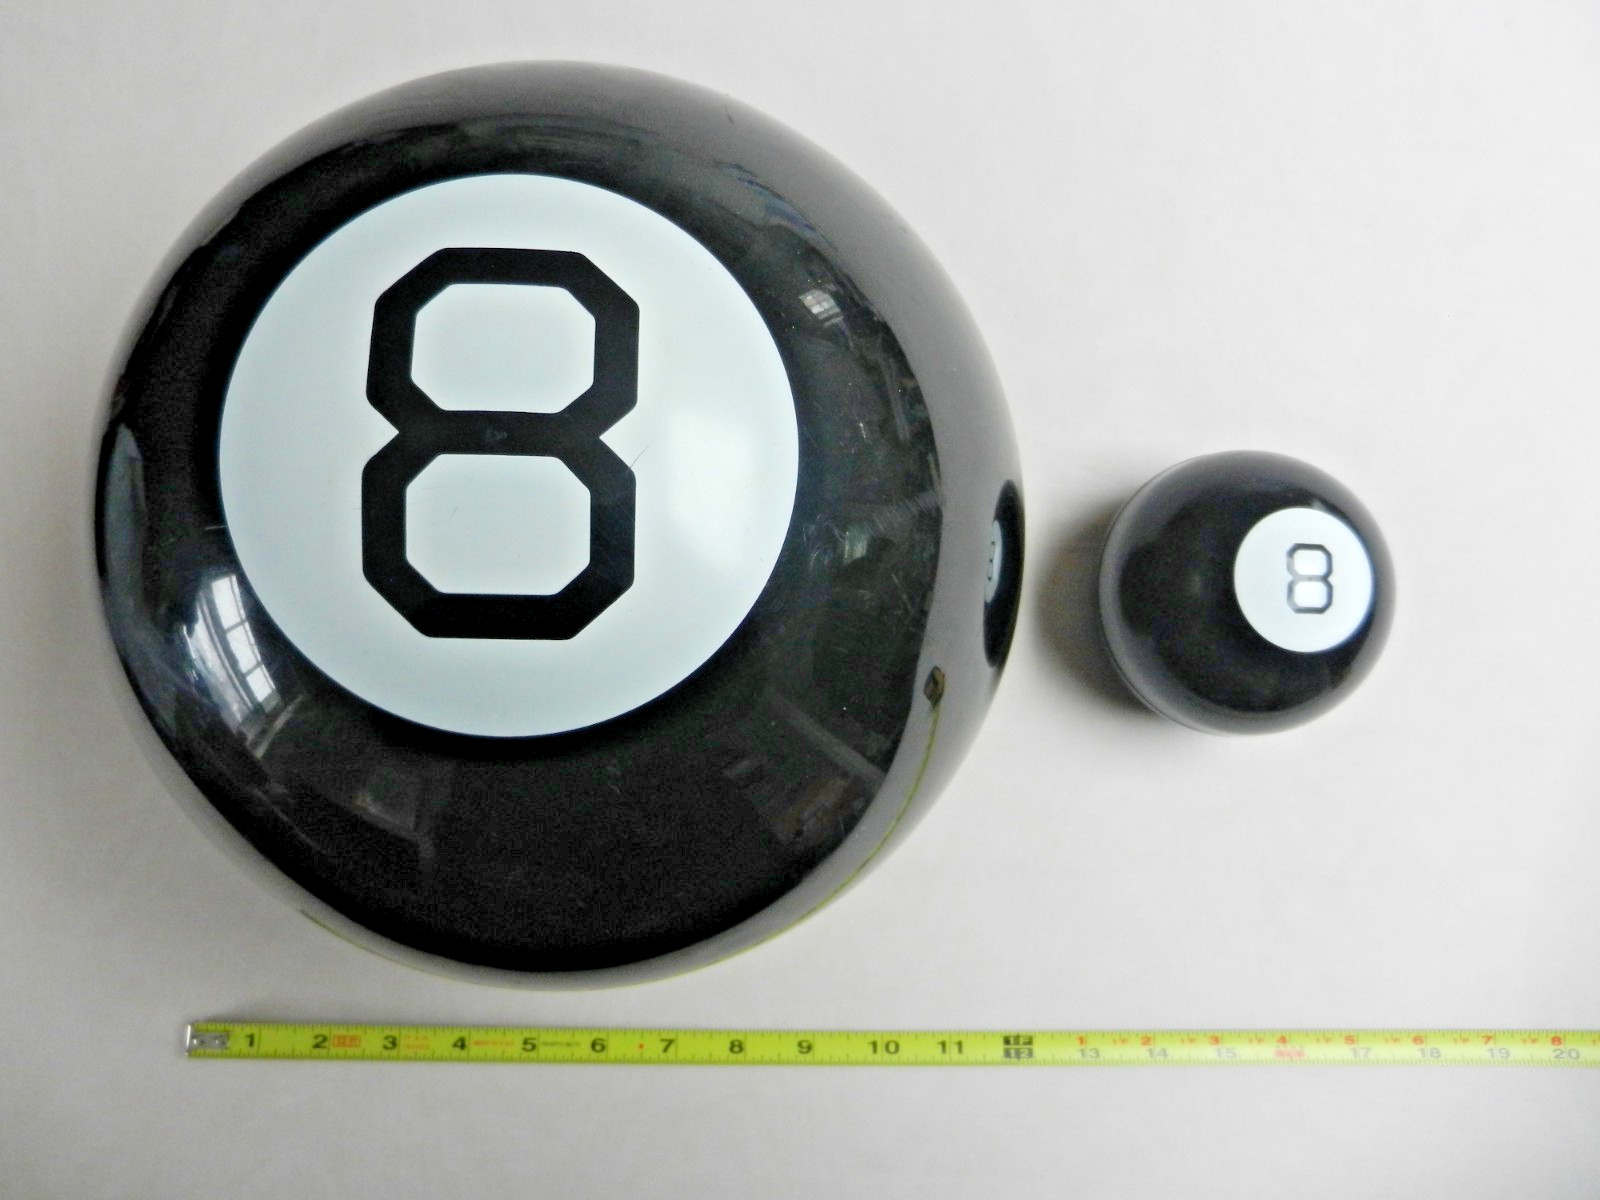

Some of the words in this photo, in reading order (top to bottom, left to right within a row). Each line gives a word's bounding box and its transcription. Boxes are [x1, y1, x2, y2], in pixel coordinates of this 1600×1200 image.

[362, 247, 640, 640] 8
[1286, 543, 1333, 614] 8
[245, 1033, 255, 1047] 1
[313, 1034, 328, 1049] 2
[383, 1035, 397, 1050] 3
[452, 1036, 467, 1051] 4
[521, 1037, 536, 1052] 5
[591, 1038, 606, 1053] 6
[659, 1038, 675, 1053] 7
[728, 1039, 744, 1054] 8
[796, 1039, 812, 1054] 9
[867, 1039, 900, 1054] 10
[936, 1040, 963, 1055] 11
[1140, 1035, 1152, 1046] 2
[1208, 1035, 1220, 1046] 3
[1412, 1035, 1425, 1046] 6
[1481, 1035, 1493, 1045] 7
[1550, 1036, 1562, 1046] 8
[1077, 1048, 1100, 1059] 13
[1146, 1048, 1168, 1059] 14
[1349, 1047, 1372, 1058] 17
[1418, 1047, 1441, 1058] 18
[1487, 1048, 1510, 1059] 19
[1552, 1048, 1580, 1060] 20
